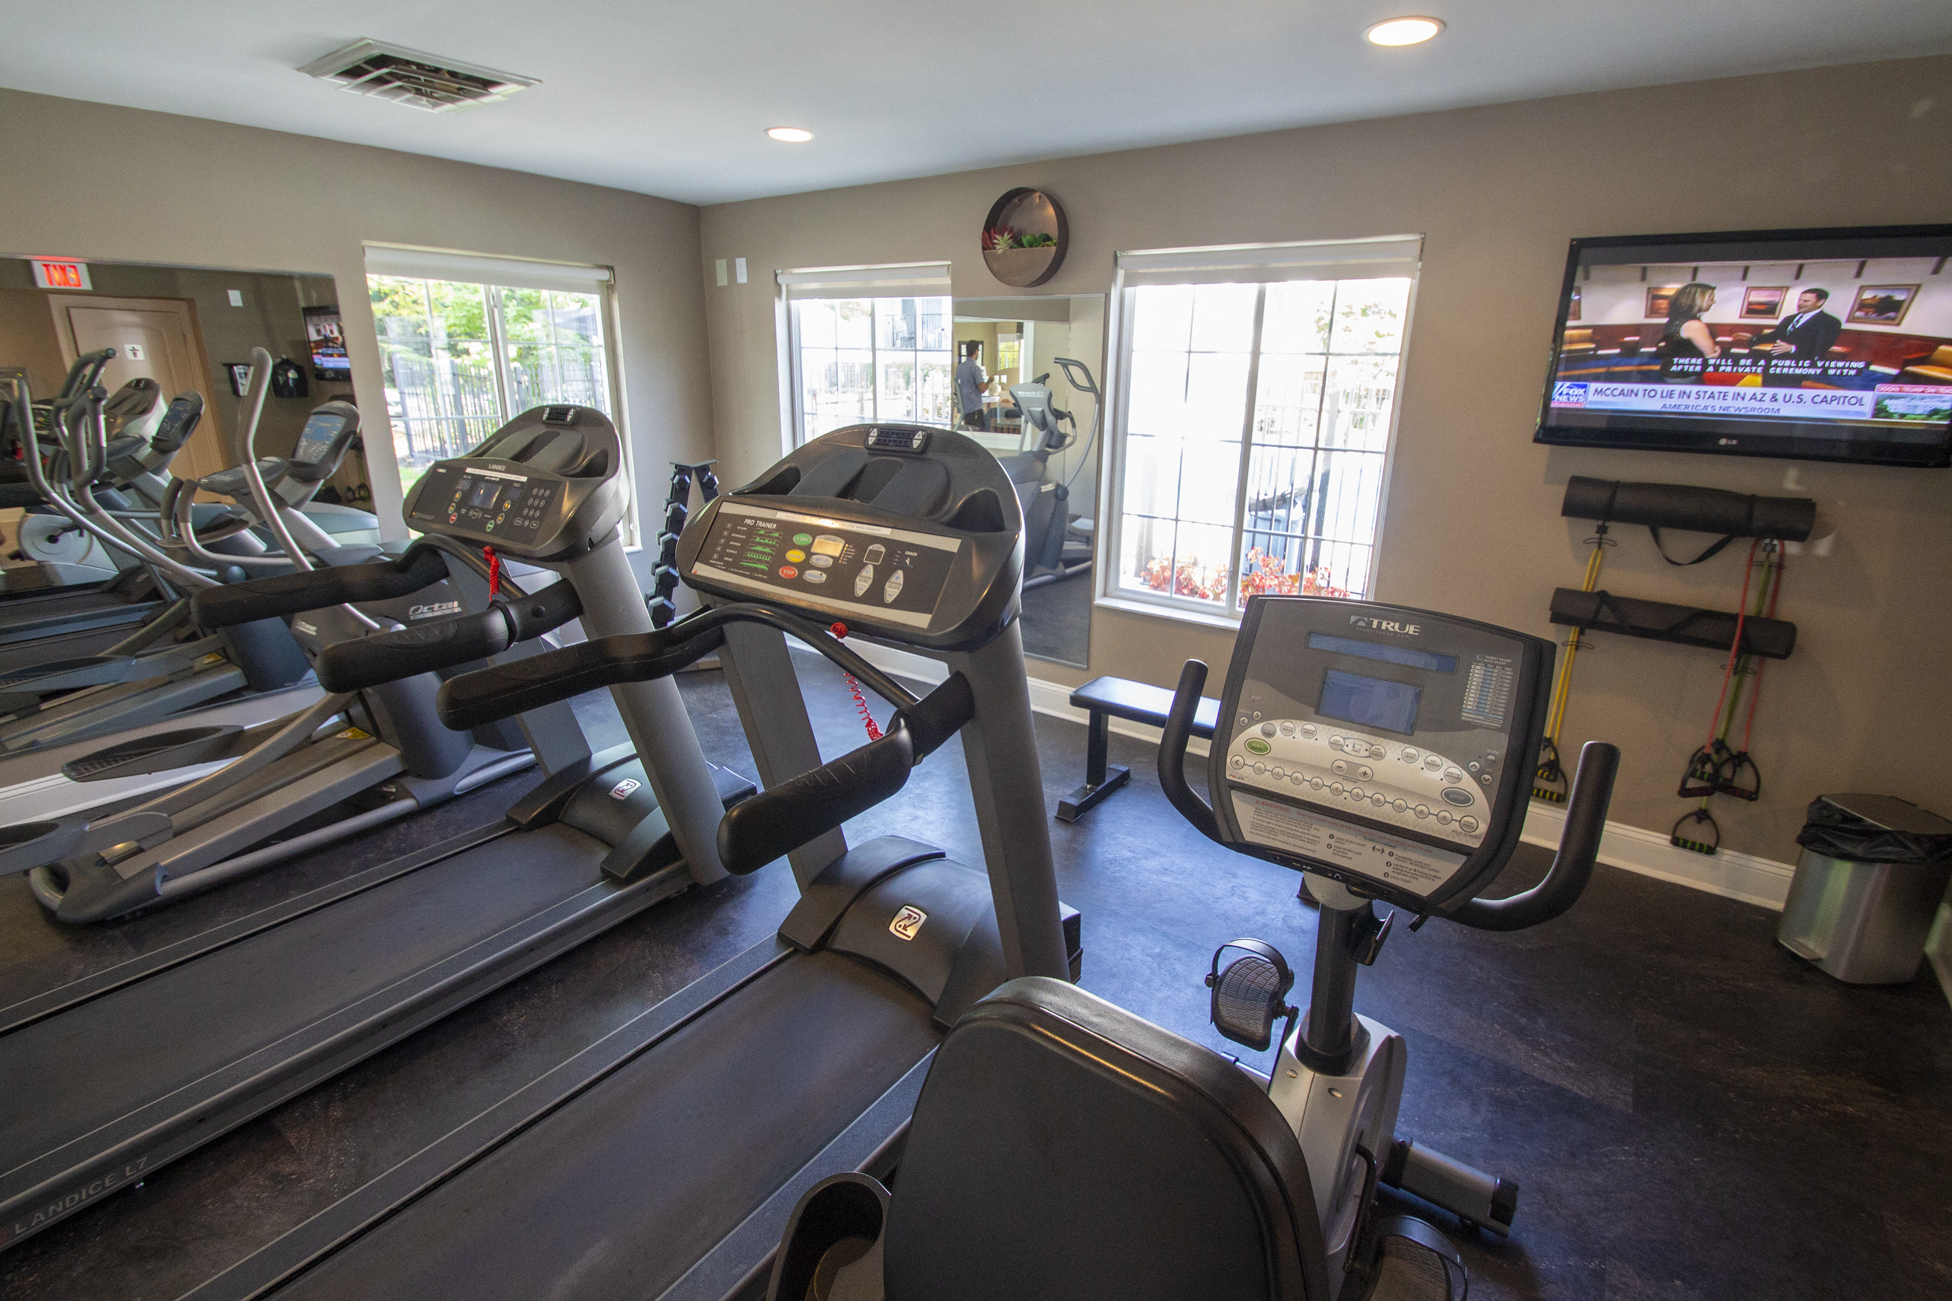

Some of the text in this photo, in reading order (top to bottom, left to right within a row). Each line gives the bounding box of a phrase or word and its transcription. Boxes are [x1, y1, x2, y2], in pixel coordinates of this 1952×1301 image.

[1672, 357, 1866, 369] THERE WILL BE A PUBLIC VIEWING
[1769, 367, 1822, 375] CEREMONY
[1827, 368, 1857, 376] WITH
[1562, 387, 1587, 395] FOX
[1592, 388, 1866, 406] MCCAIN TO LIE IN STATE IN AZ & U.S. CAPITOL
[1660, 403, 1781, 415] AMERICA'S NEWSROOM
[755, 520, 777, 529] TRAINER
[1368, 617, 1421, 636] TRUE
[1261, 801, 1291, 813] WARNING!
[14, 1156, 148, 1235] LANDICE L7
